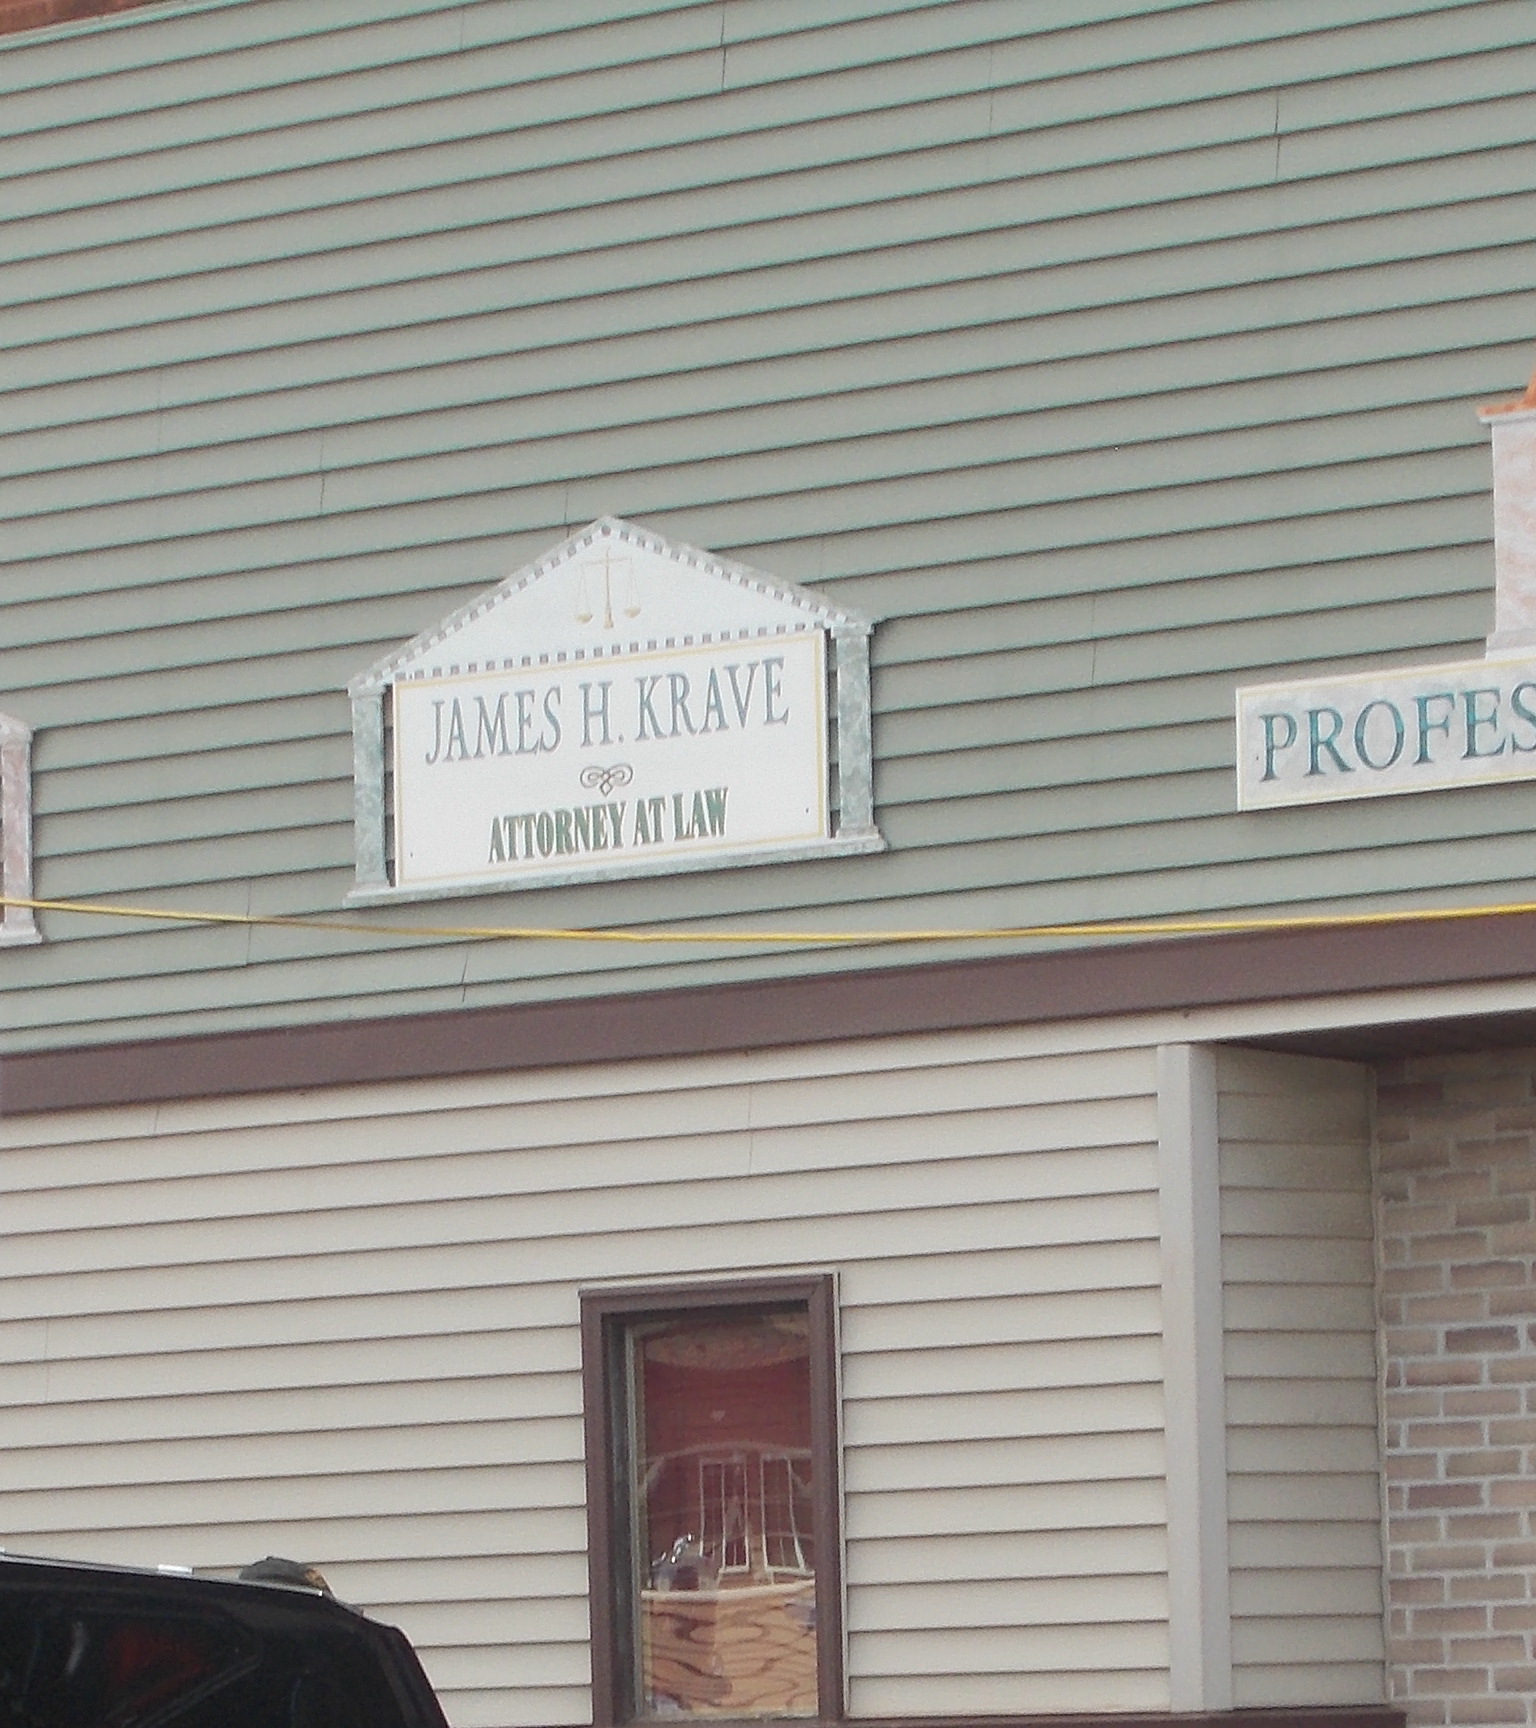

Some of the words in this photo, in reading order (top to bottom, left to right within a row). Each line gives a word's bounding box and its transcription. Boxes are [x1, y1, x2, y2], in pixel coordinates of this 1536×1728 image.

[425, 684, 562, 765] JAMES
[635, 656, 790, 740] KRAVE
[487, 801, 627, 864] ATTORNEY
[632, 796, 666, 845] AT
[671, 787, 729, 840] LAW
